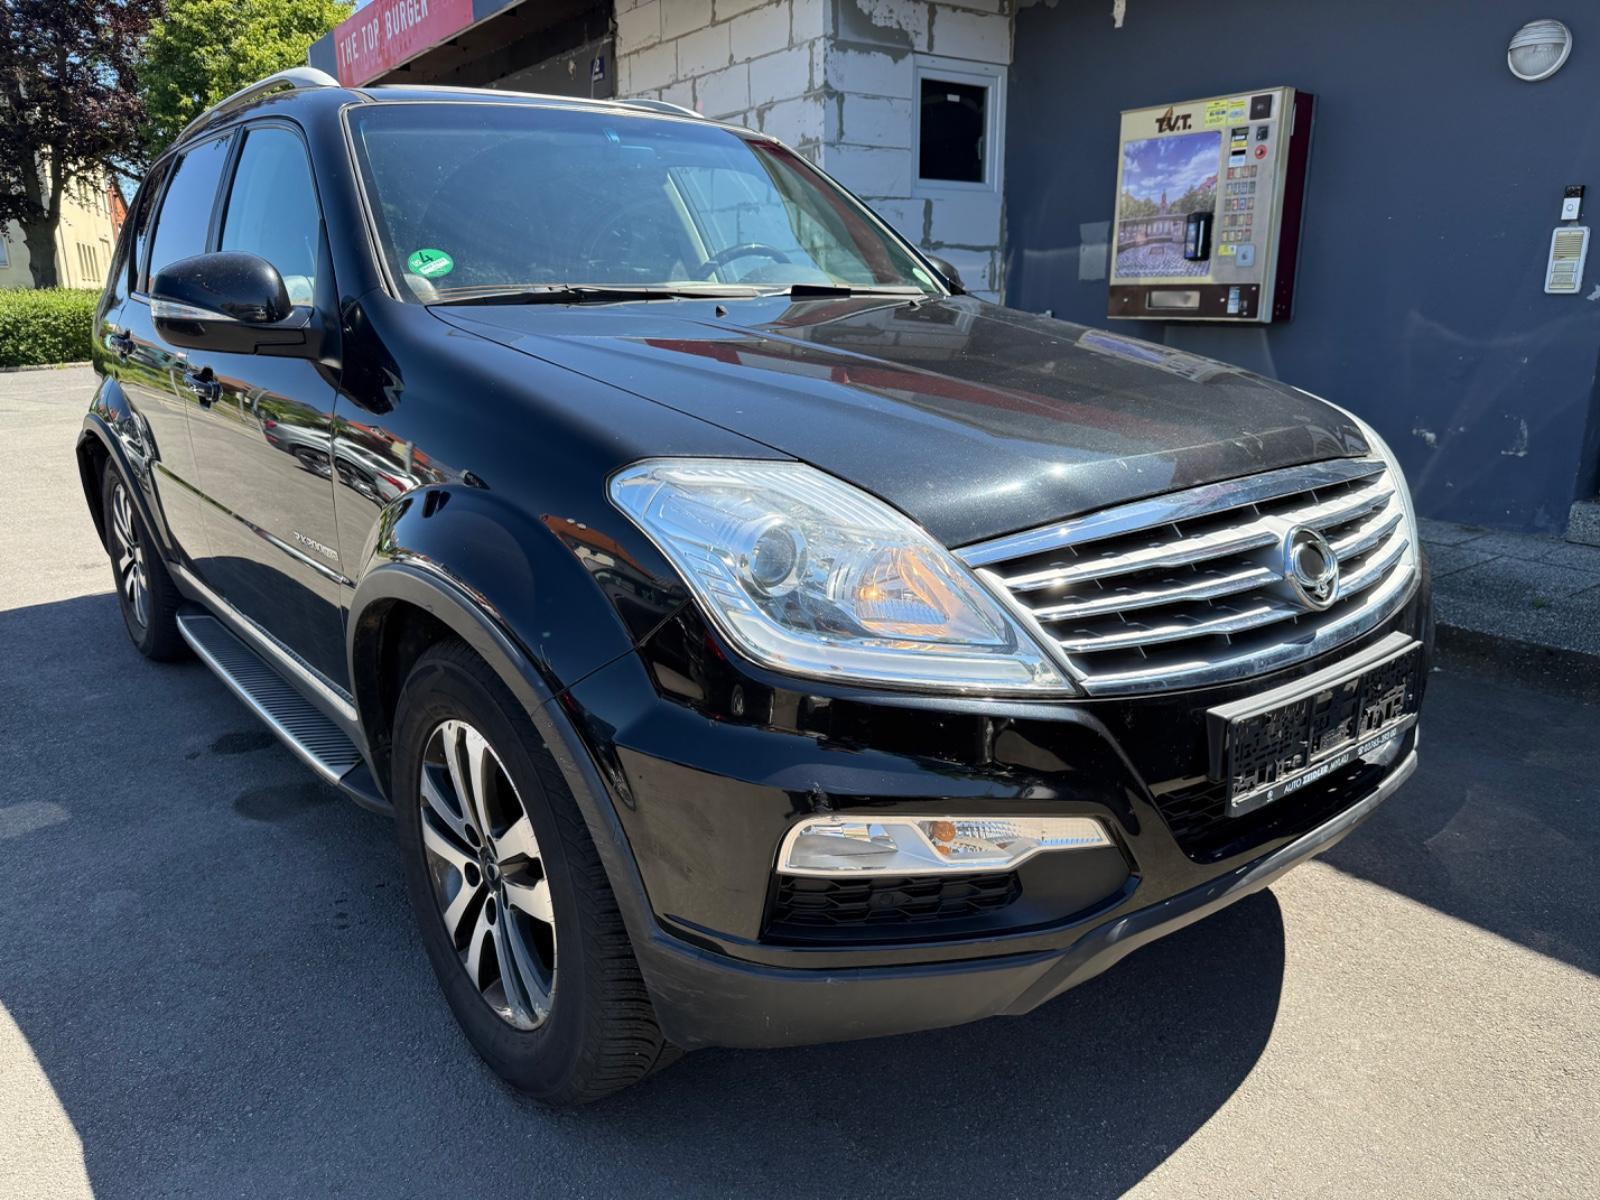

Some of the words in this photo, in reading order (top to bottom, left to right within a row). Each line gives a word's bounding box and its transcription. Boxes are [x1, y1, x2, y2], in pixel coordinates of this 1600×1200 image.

[340, 32, 358, 68] THE
[361, 17, 380, 54] TOP
[384, 0, 428, 40] BURGER
[419, 251, 433, 263] 4
[1284, 778, 1301, 794] AUTO
